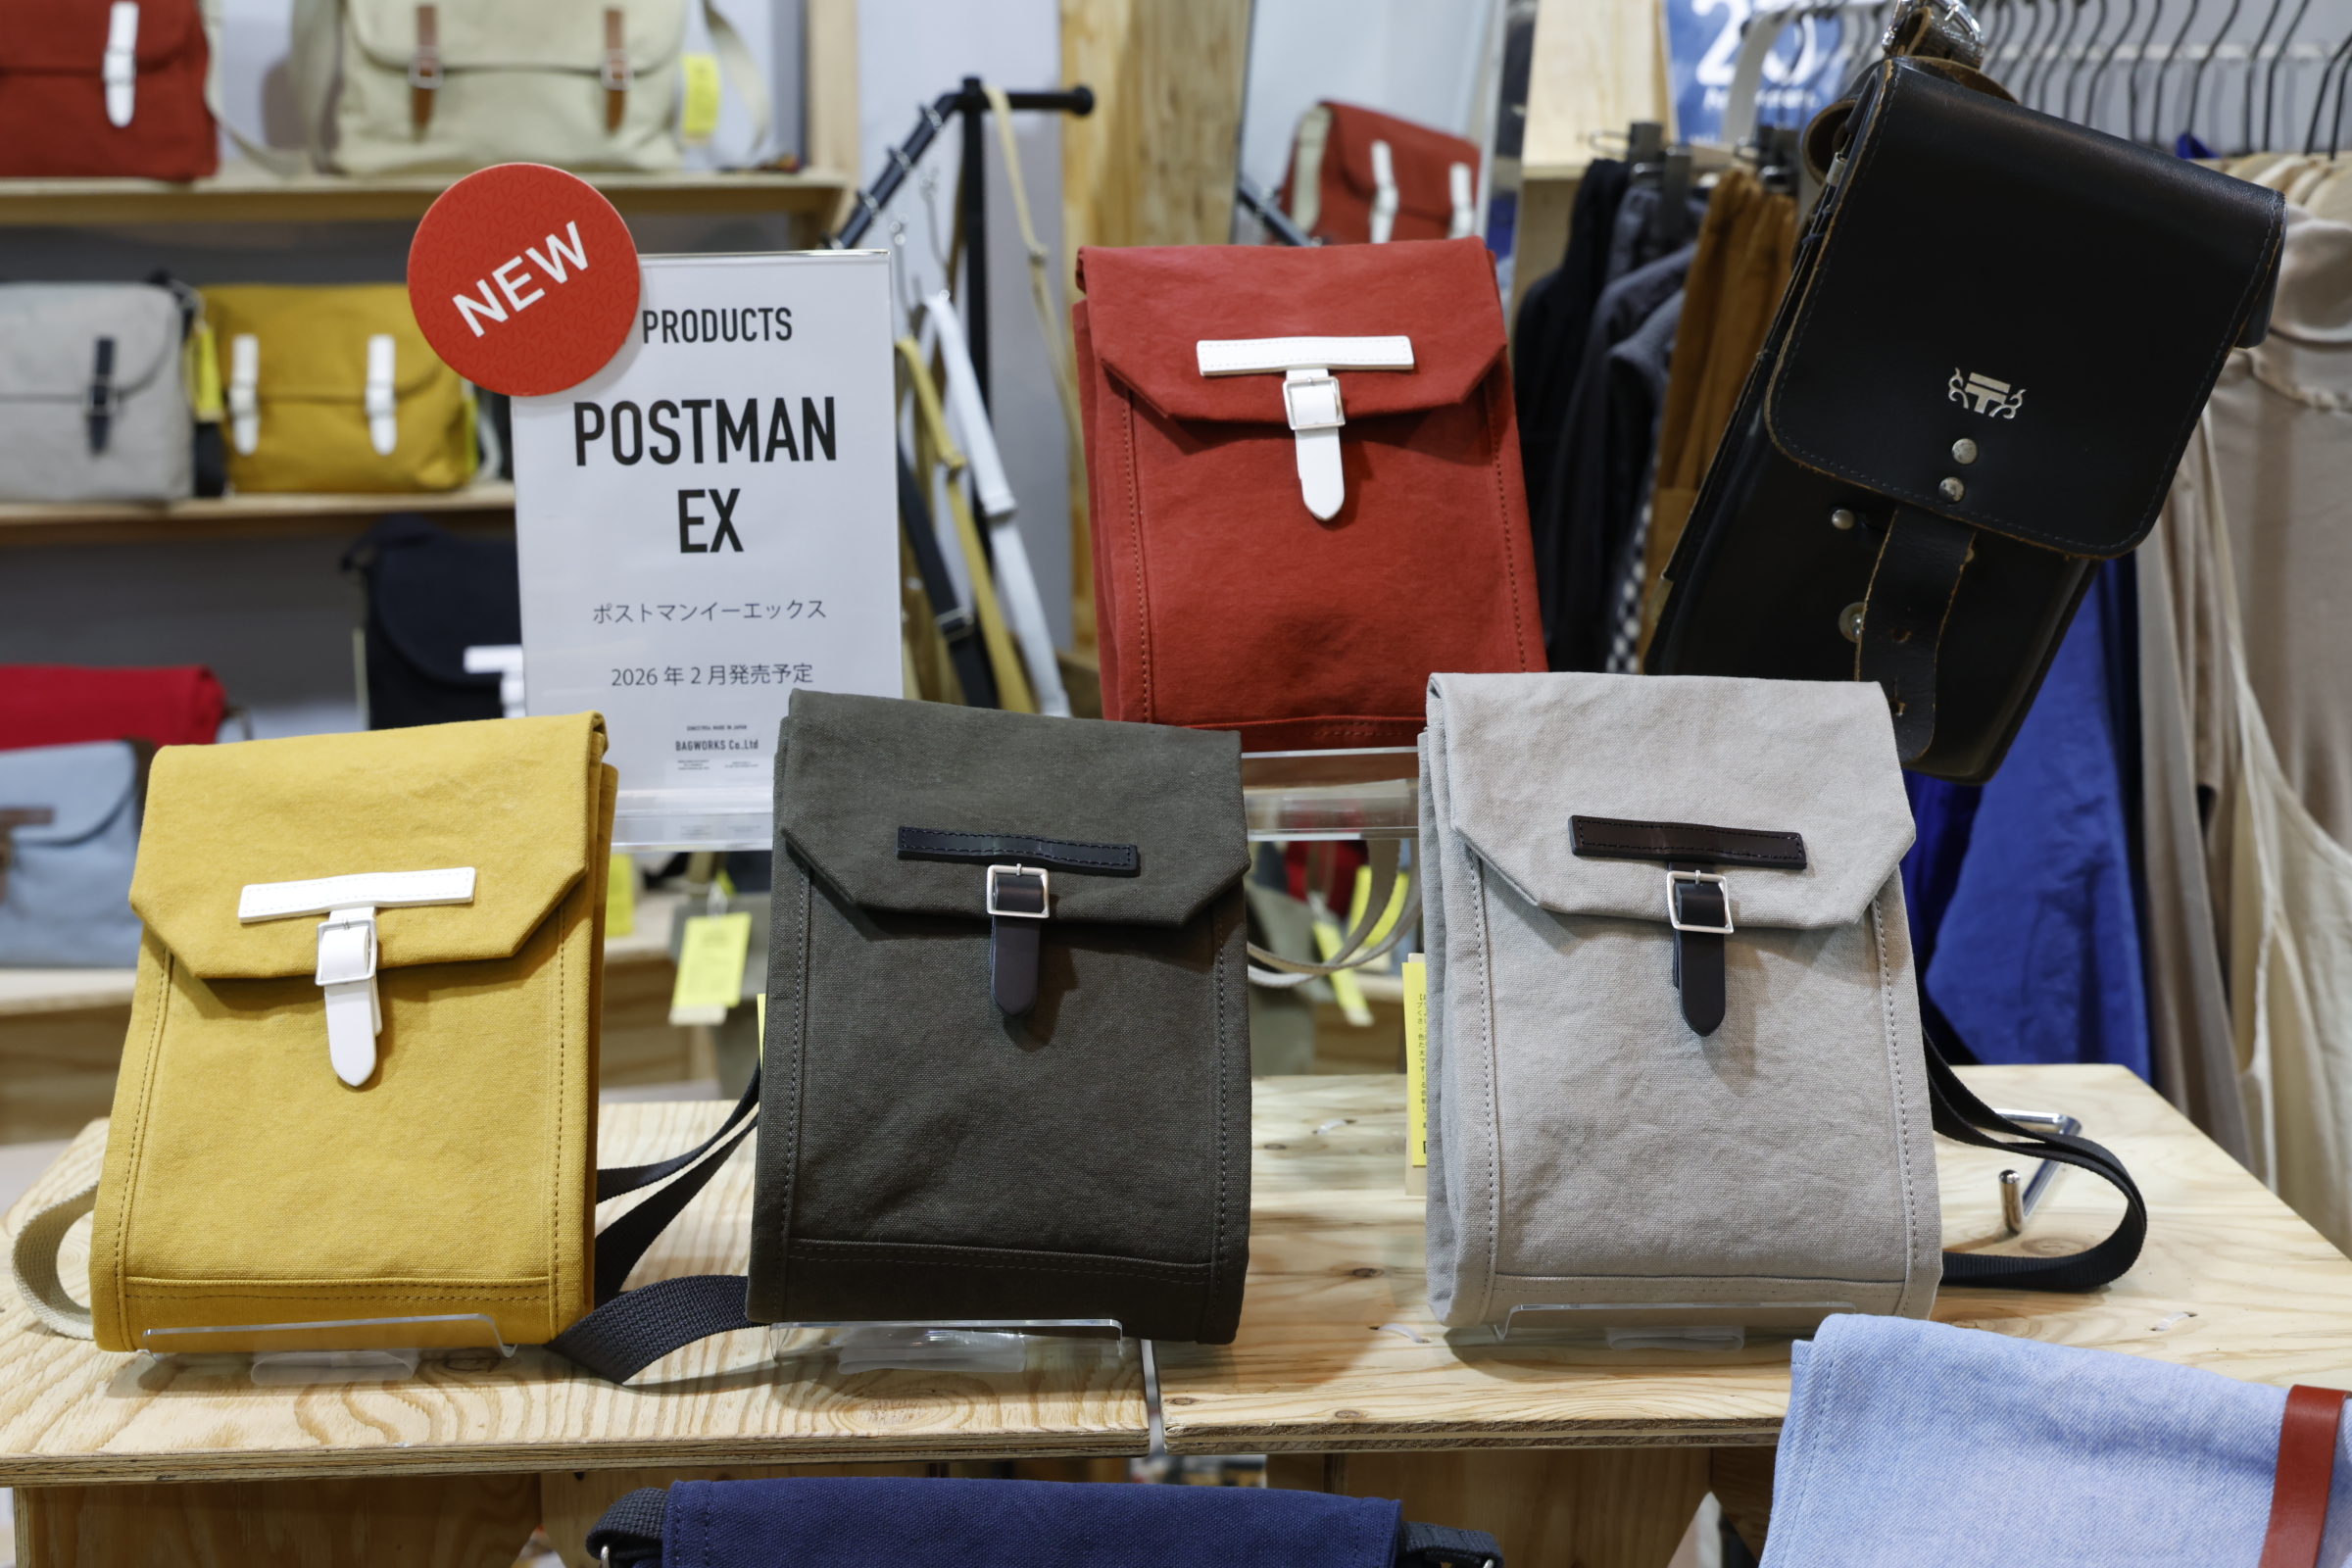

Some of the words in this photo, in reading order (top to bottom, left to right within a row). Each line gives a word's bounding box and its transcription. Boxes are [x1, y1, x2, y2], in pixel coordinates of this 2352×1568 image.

[452, 220, 589, 338] NEW
[642, 307, 793, 344] PRODUCTS
[573, 396, 837, 466] POSTMAN
[677, 487, 745, 554] EX
[593, 600, 826, 624] ポストマンイーエックス
[675, 740, 726, 752] BAGWORKS
